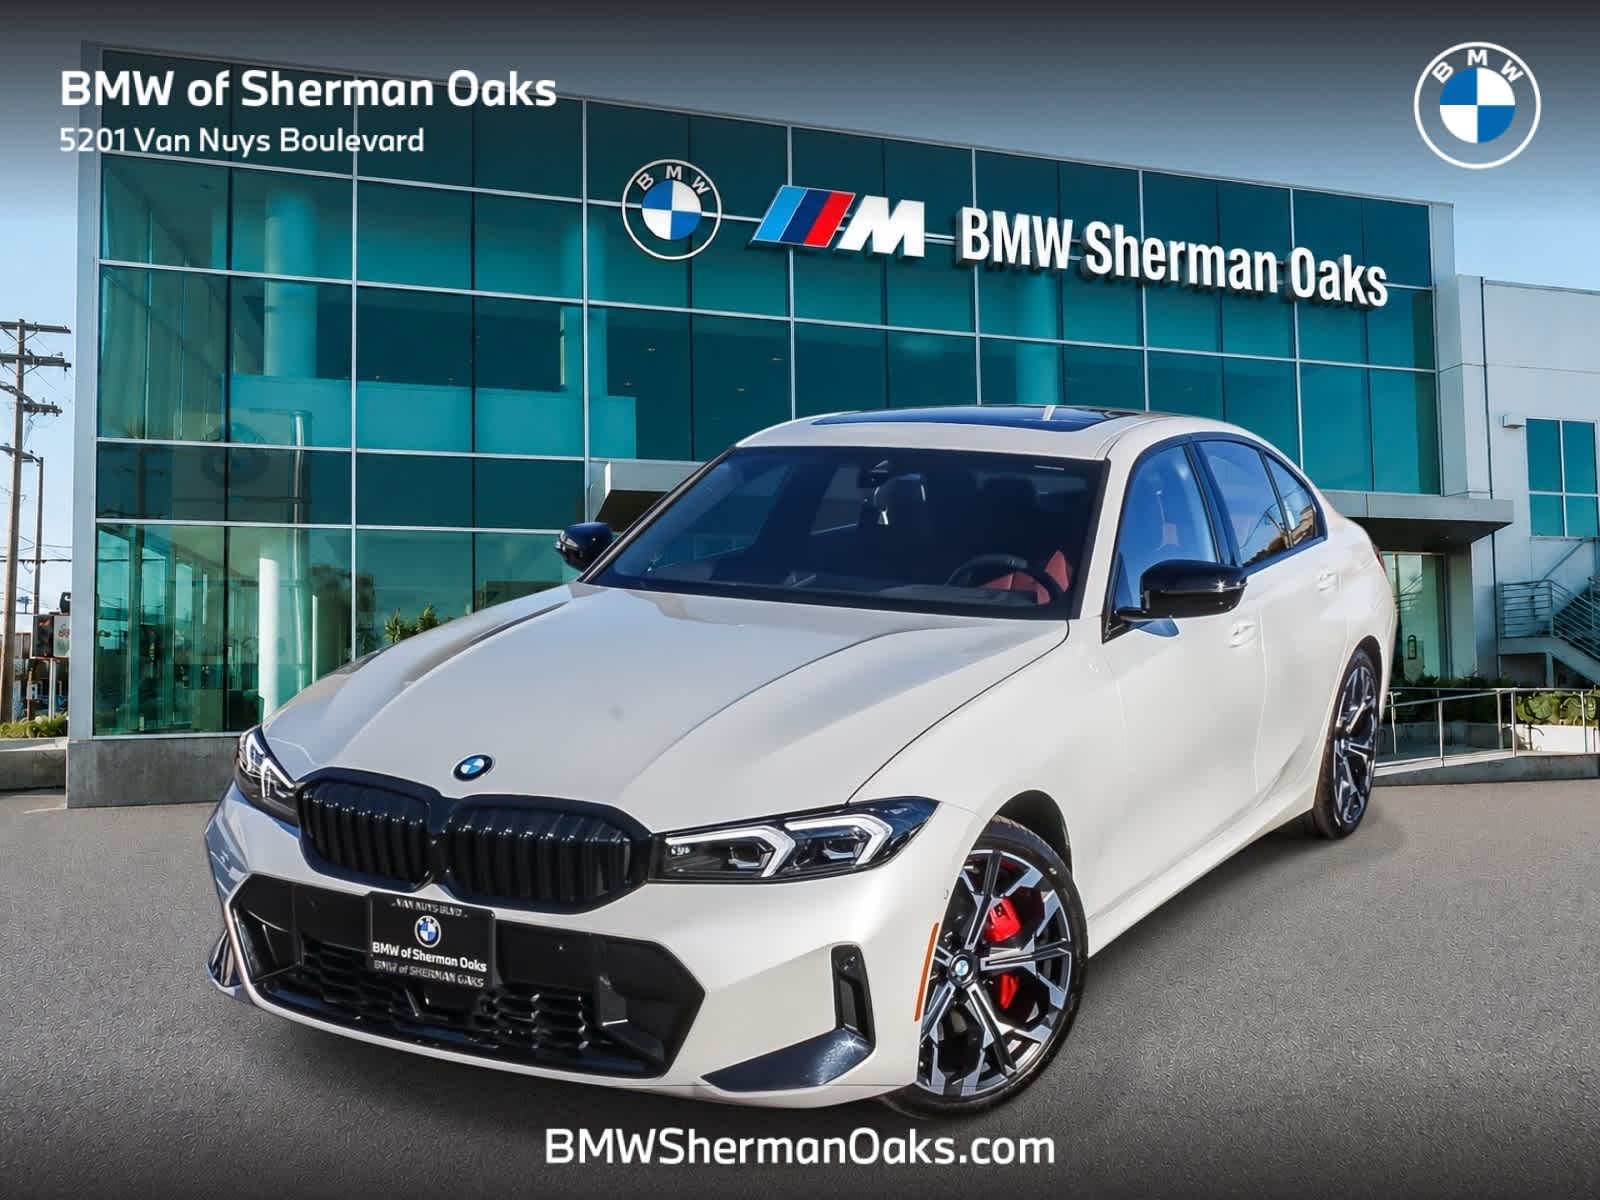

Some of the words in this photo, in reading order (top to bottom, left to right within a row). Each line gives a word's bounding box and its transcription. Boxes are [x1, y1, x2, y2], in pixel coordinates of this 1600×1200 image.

[635, 165, 711, 197] BMW
[836, 195, 925, 258] M
[961, 206, 1073, 270] BMW
[1084, 221, 1278, 293] Sherman
[1290, 247, 1388, 307] Oaks
[372, 941, 400, 957] BMW
[401, 947, 412, 959] of
[412, 948, 458, 967] Sherman
[459, 957, 488, 973] Oaks
[374, 960, 398, 972] BMW
[398, 965, 409, 975] of
[409, 966, 456, 983] SHERMAN
[457, 974, 484, 988] OAKS
